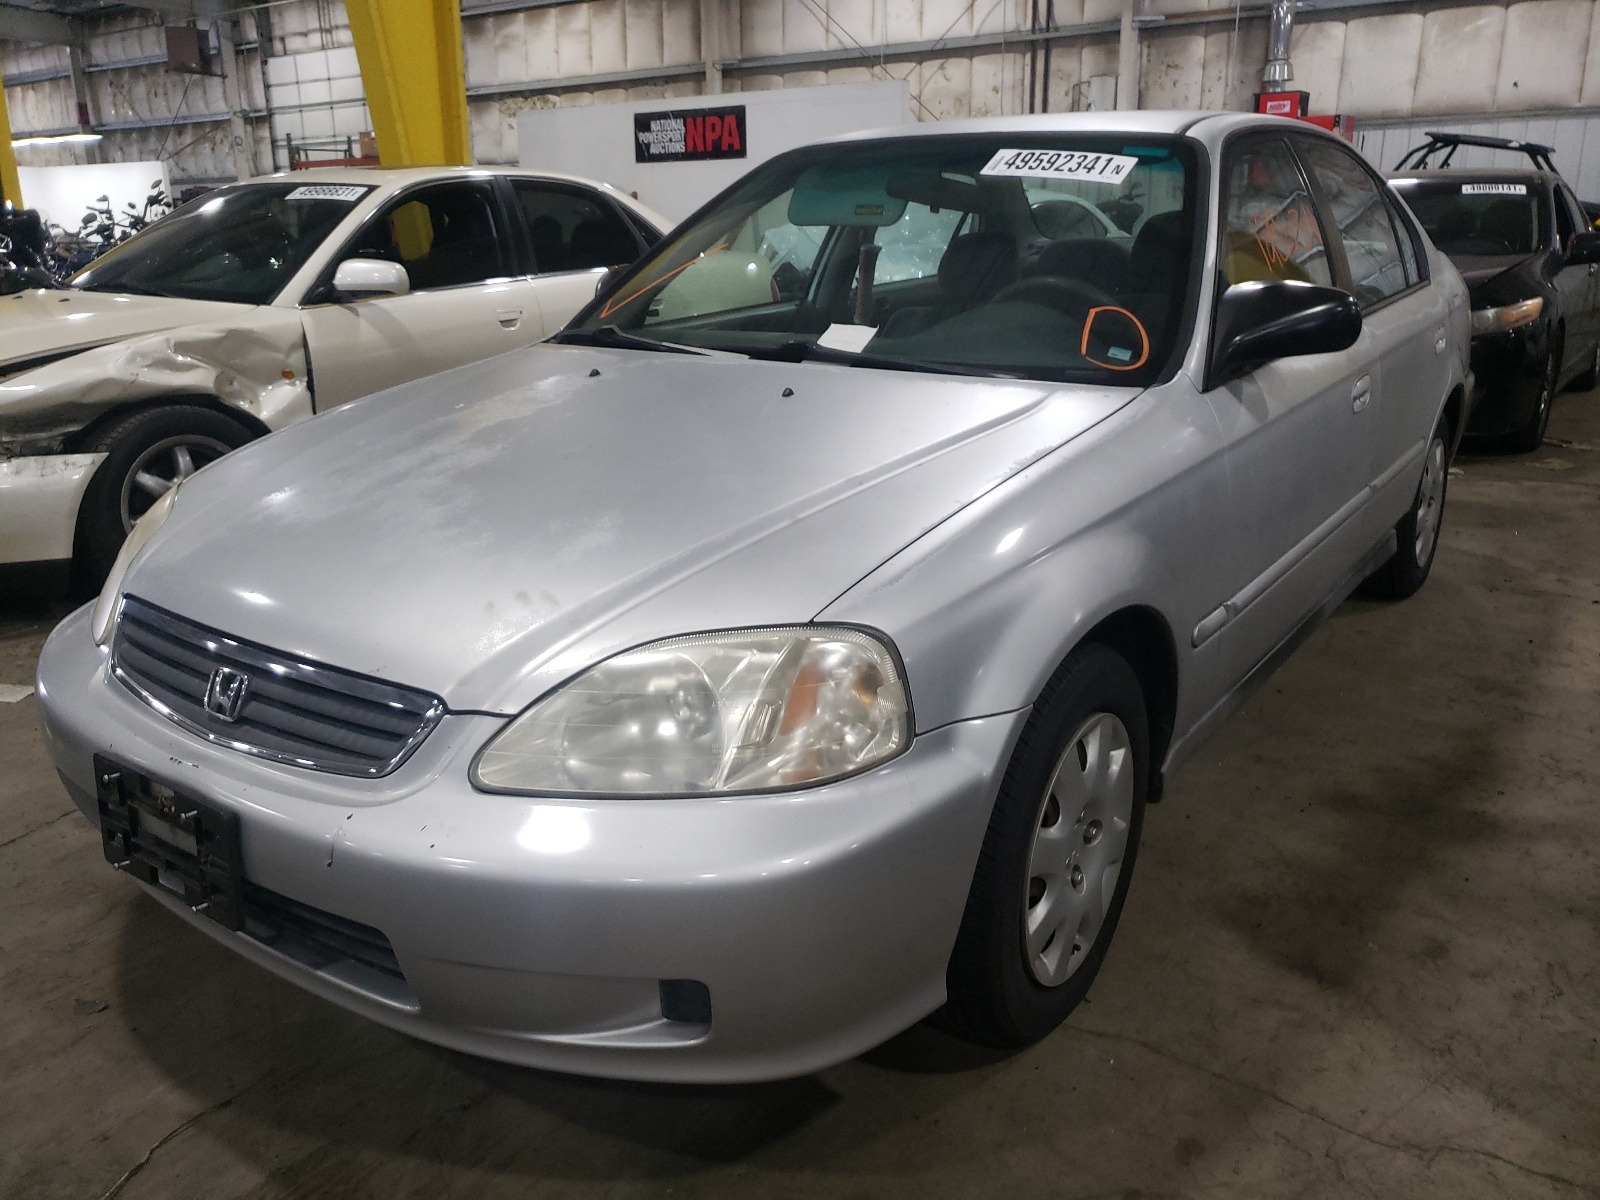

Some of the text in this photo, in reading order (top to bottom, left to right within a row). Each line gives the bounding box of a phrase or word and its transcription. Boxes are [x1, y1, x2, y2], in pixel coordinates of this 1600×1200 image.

[650, 118, 685, 132] NATIONAL
[638, 130, 685, 144] POWERSPORT
[685, 114, 741, 153] NPA
[649, 141, 686, 155] AUCTIONS
[1003, 151, 1114, 175] 49592341
[1111, 164, 1126, 175] N
